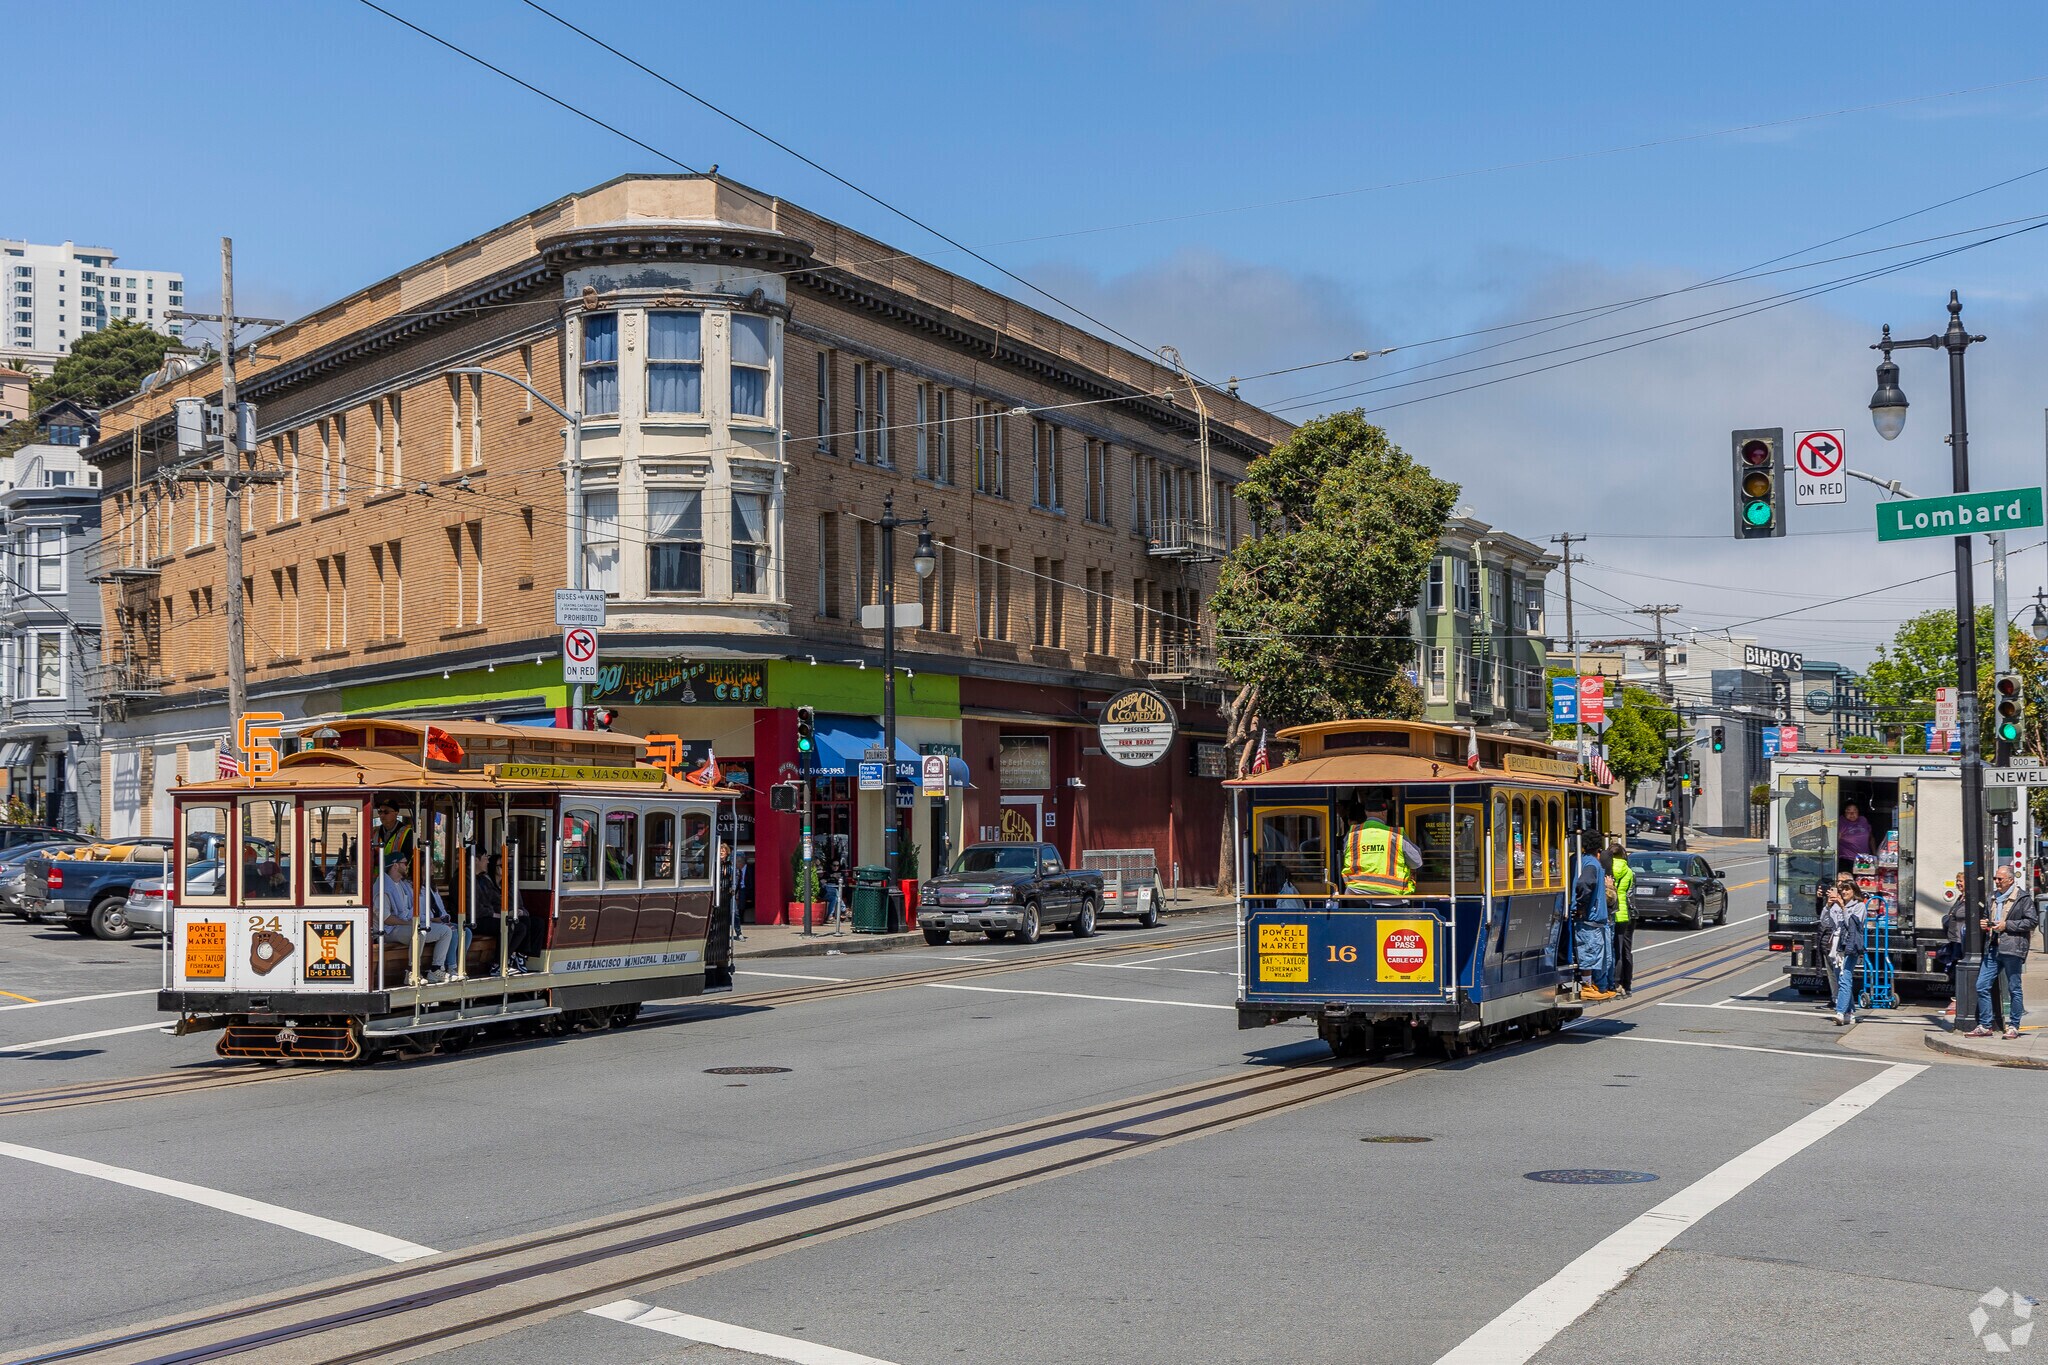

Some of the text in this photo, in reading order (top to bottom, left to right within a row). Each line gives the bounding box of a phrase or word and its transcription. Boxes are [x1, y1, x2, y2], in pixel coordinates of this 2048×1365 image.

[1799, 482, 1843, 496] ON RED
[1897, 499, 2021, 531] Lombard
[563, 614, 598, 622] PROHIBITED
[1745, 647, 1802, 671] BIMBO'S
[566, 666, 595, 675] ON RED
[592, 663, 763, 705] 901 Columbus Cafe
[1136, 692, 1166, 722] CLUB
[1118, 709, 1156, 722] COMEDY
[866, 751, 888, 759] COLUMBUS
[900, 763, 915, 775] Cafe
[1511, 757, 1537, 769] POWELL
[508, 767, 570, 779] POWELL
[575, 769, 585, 779] &
[592, 769, 640, 780] MASON
[799, 767, 845, 775] (45) 655-3953
[896, 796, 913, 806] TM
[719, 814, 756, 823] COLMBUS
[1002, 808, 1034, 842] CLUB
[1361, 844, 1385, 852] SFMTA
[249, 916, 282, 932] 24
[569, 915, 587, 930] 24
[1781, 914, 1818, 922] Message
[187, 954, 197, 962] BAY
[205, 954, 224, 962] TAYLOR
[1327, 945, 1358, 963] 16
[566, 952, 688, 971] SAN FRANCISCO MUNICIPAL RAILWAY
[1262, 956, 1273, 965] BAY
[1283, 956, 1306, 965] TAYLOR
[1793, 976, 1824, 985] SUPREME
[275, 1033, 299, 1042] GIANTS
